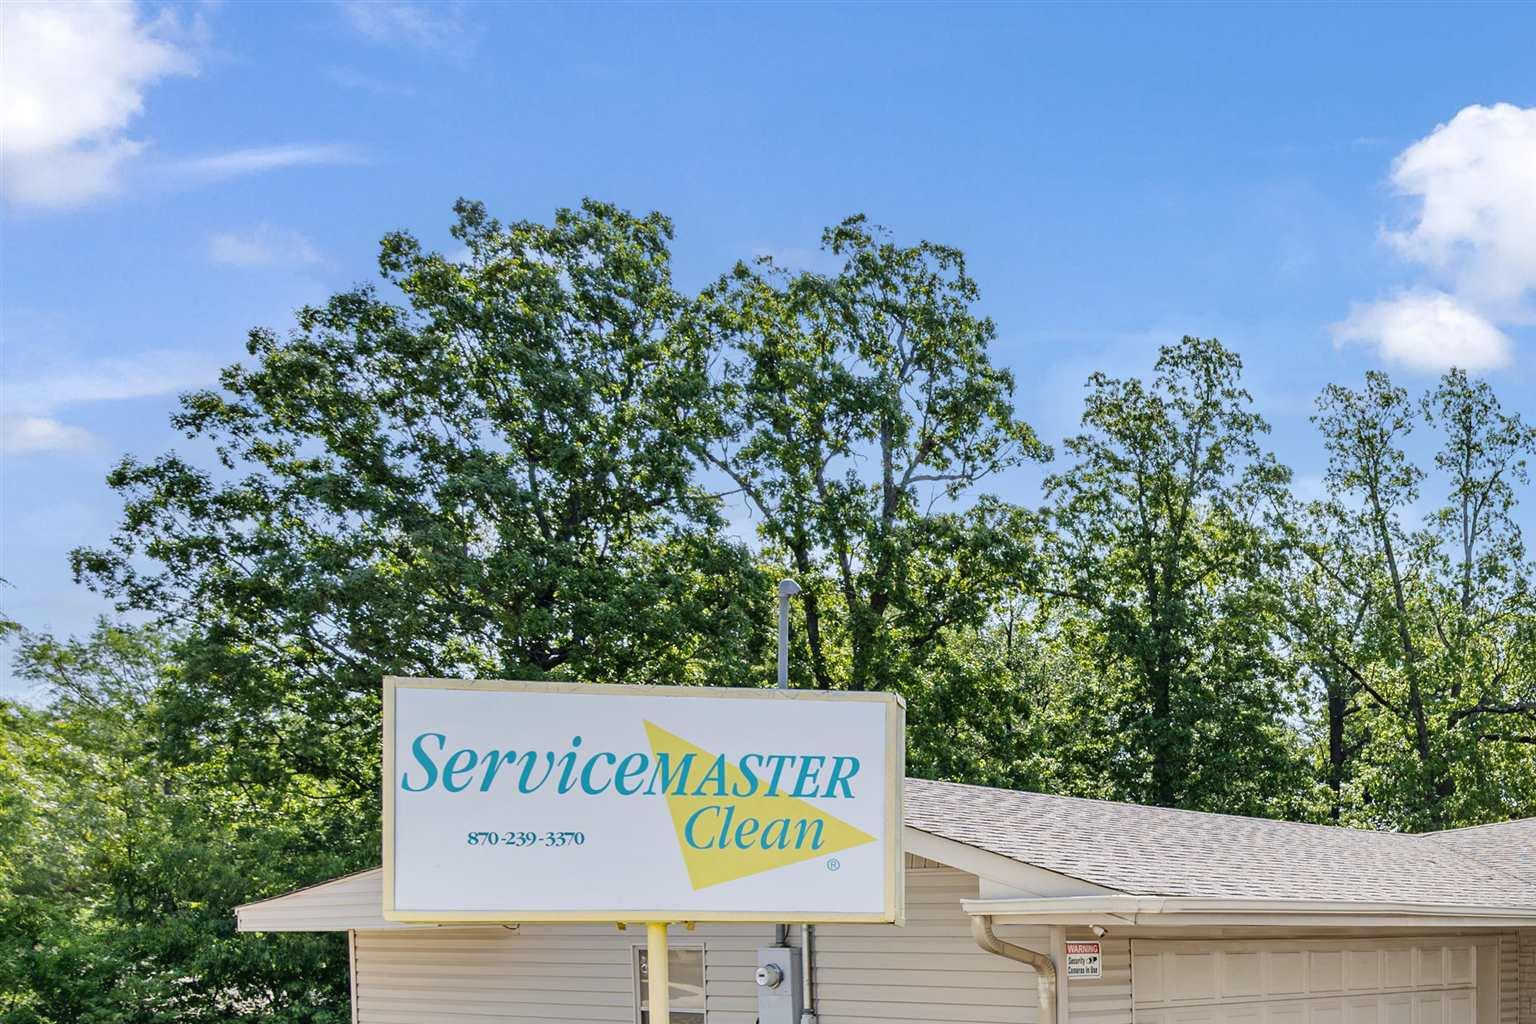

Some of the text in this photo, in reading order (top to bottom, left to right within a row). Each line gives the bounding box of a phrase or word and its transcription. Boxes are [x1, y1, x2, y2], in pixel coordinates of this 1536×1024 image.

[401, 731, 861, 799] ServiceMASTER
[467, 830, 586, 847] 870-239-3370
[684, 805, 825, 851] Clean
[1067, 944, 1098, 953] WARNING
